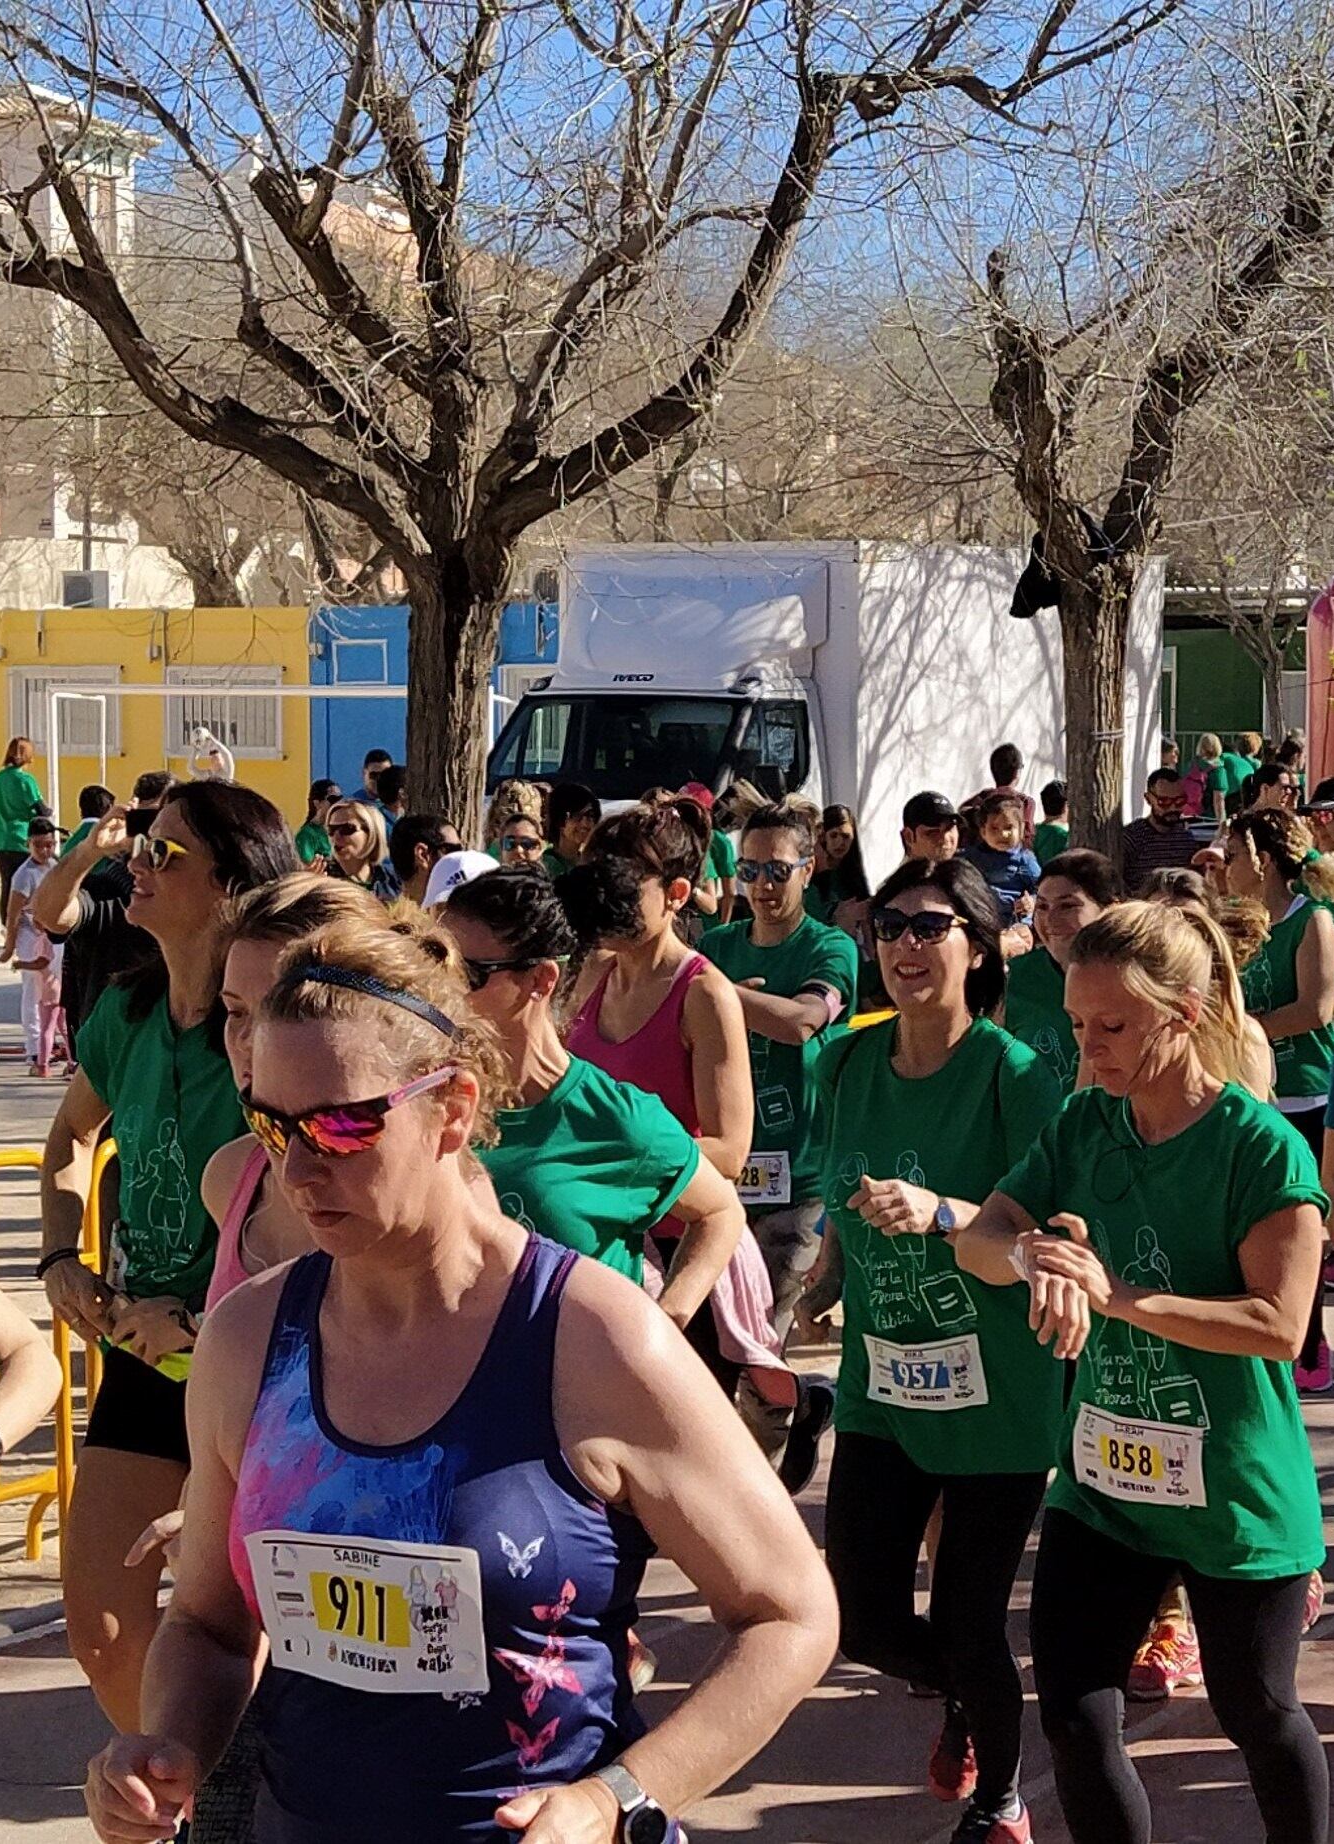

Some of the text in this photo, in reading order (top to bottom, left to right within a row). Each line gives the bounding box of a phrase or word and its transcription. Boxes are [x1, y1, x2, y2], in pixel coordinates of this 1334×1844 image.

[613, 674, 654, 682] IVECO
[734, 1166, 760, 1187] 28
[897, 1362, 939, 1389] 957
[1108, 1439, 1153, 1477] 858
[333, 1548, 381, 1568] SABINE
[328, 1576, 386, 1643] 911
